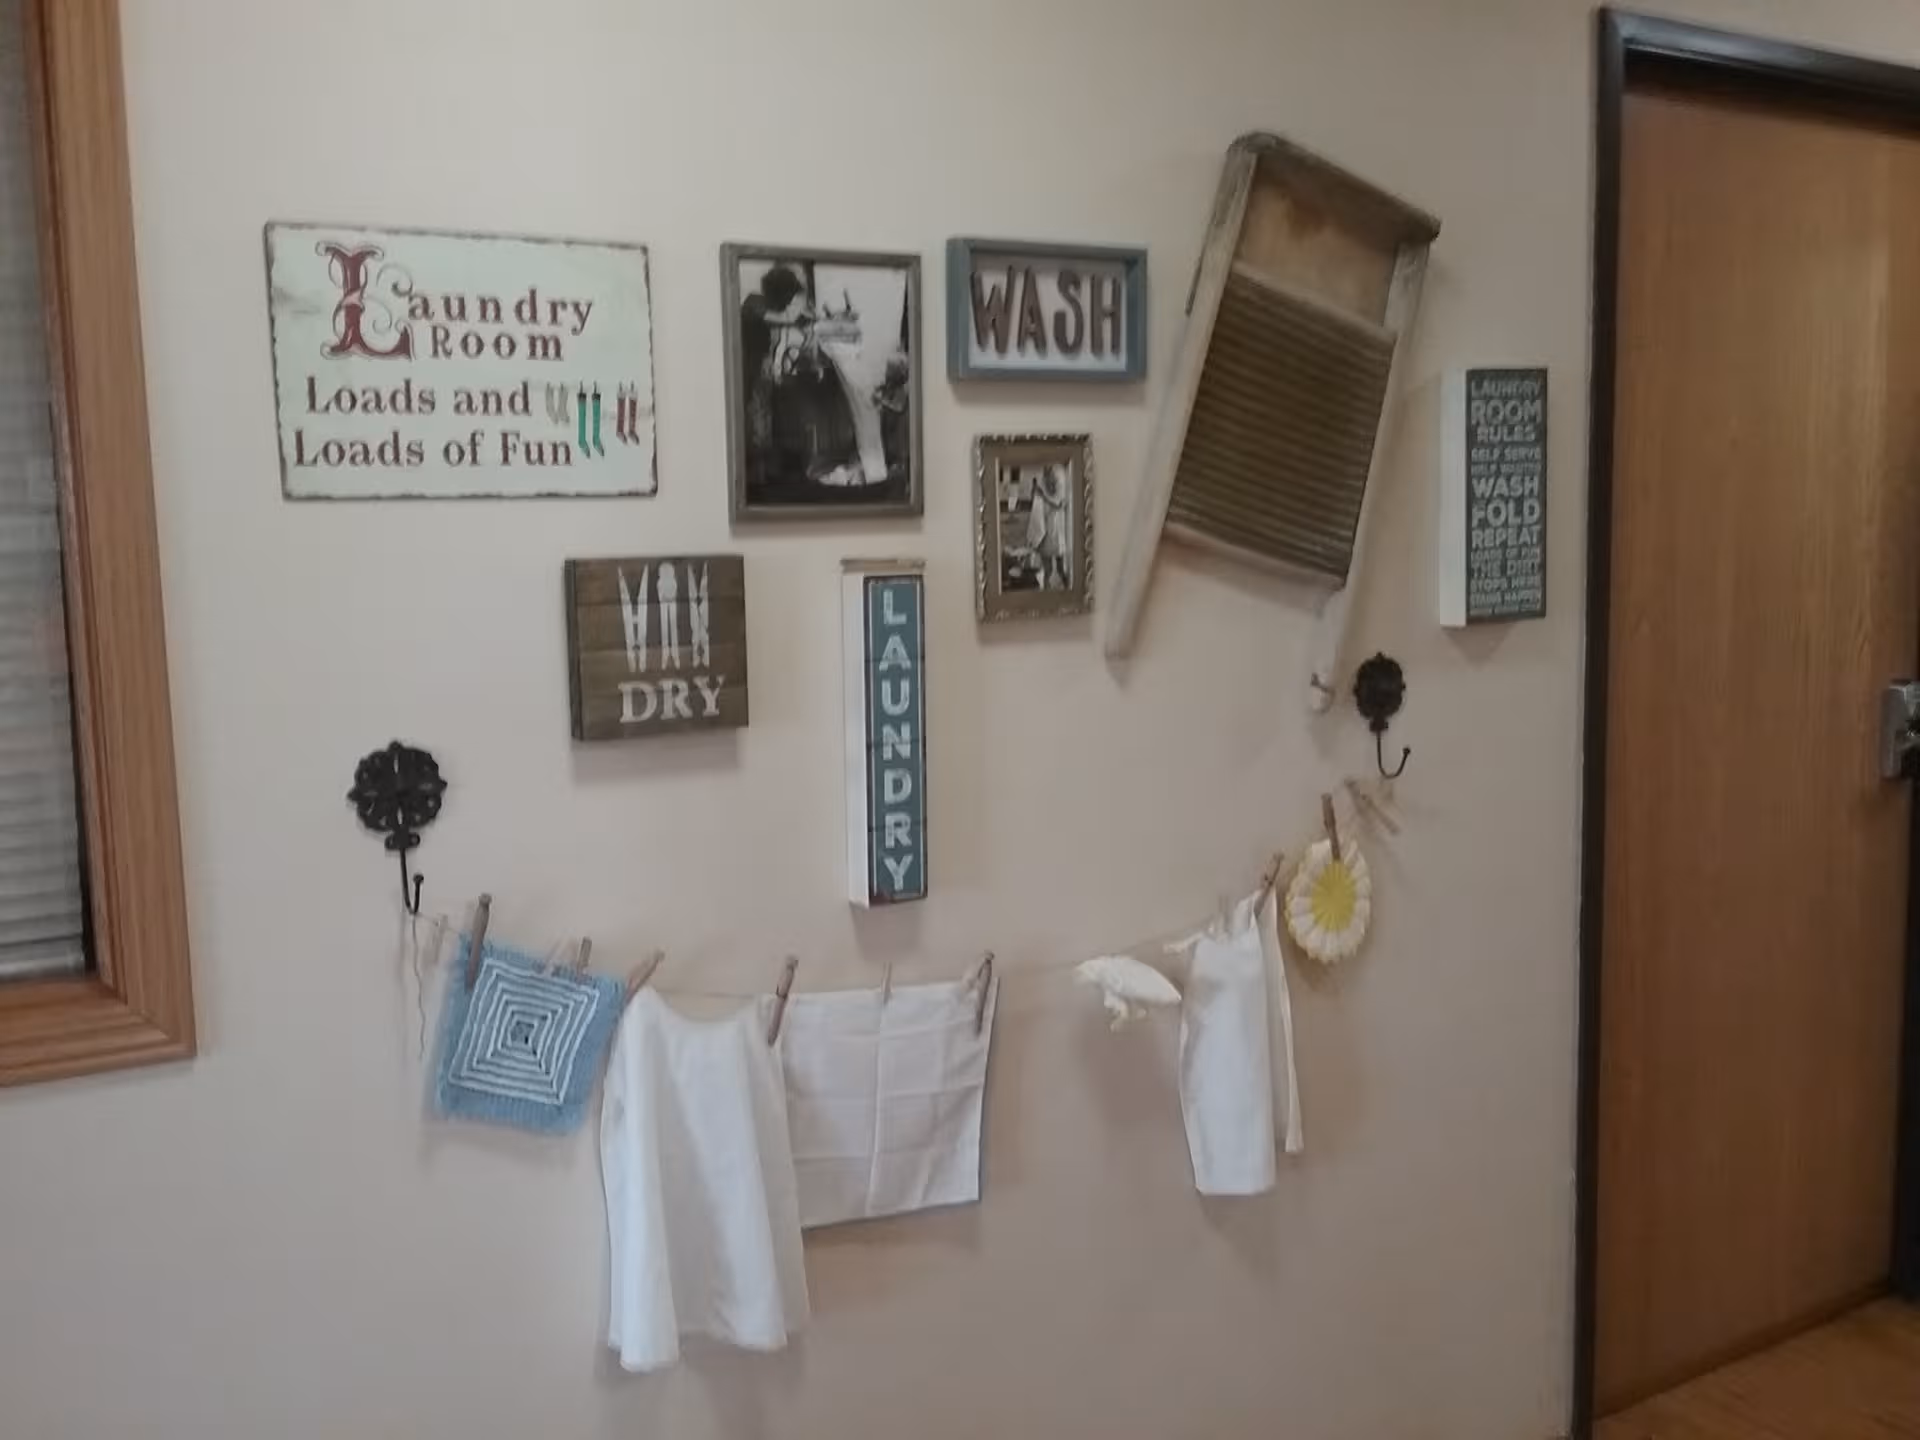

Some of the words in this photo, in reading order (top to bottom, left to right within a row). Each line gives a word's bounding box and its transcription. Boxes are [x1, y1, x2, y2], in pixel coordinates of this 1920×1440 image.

[315, 241, 593, 361] Laundry
[970, 265, 1122, 360] WASH
[431, 325, 564, 361] Room
[306, 376, 436, 415] Loads
[454, 380, 532, 416] and
[1472, 399, 1541, 424] ROOM
[294, 430, 425, 468] Loads
[443, 431, 484, 467] of
[499, 432, 573, 468] Fun
[1472, 475, 1538, 498] WASH
[1472, 499, 1540, 527] FOLD
[1472, 526, 1541, 548] REPEAT
[618, 674, 726, 724] DRY
[879, 589, 913, 890] LAUNDRY
